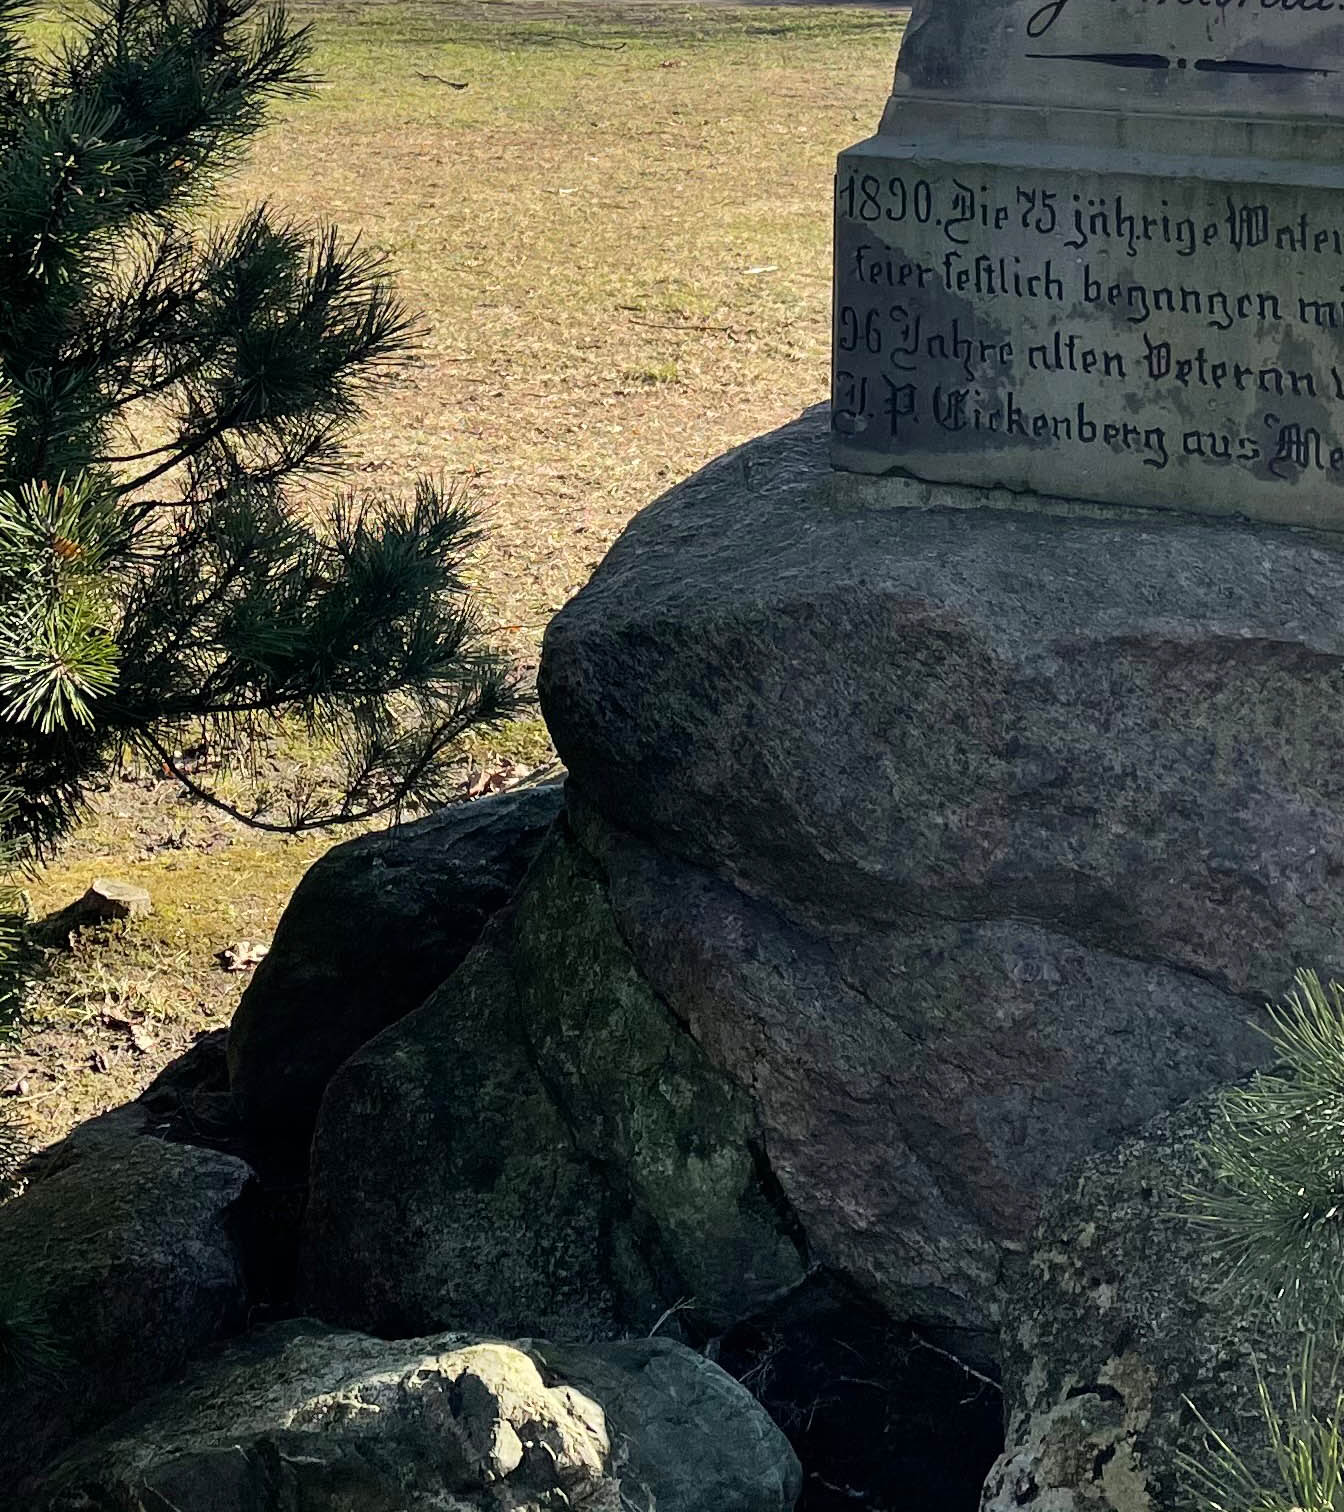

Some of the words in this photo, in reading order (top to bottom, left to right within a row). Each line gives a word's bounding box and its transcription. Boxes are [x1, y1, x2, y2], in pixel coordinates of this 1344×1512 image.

[943, 178, 1010, 246] Die
[1016, 186, 1057, 235] 75
[840, 305, 882, 355] 96
[888, 304, 1014, 382] Jahre
[1181, 429, 1261, 461] aus
